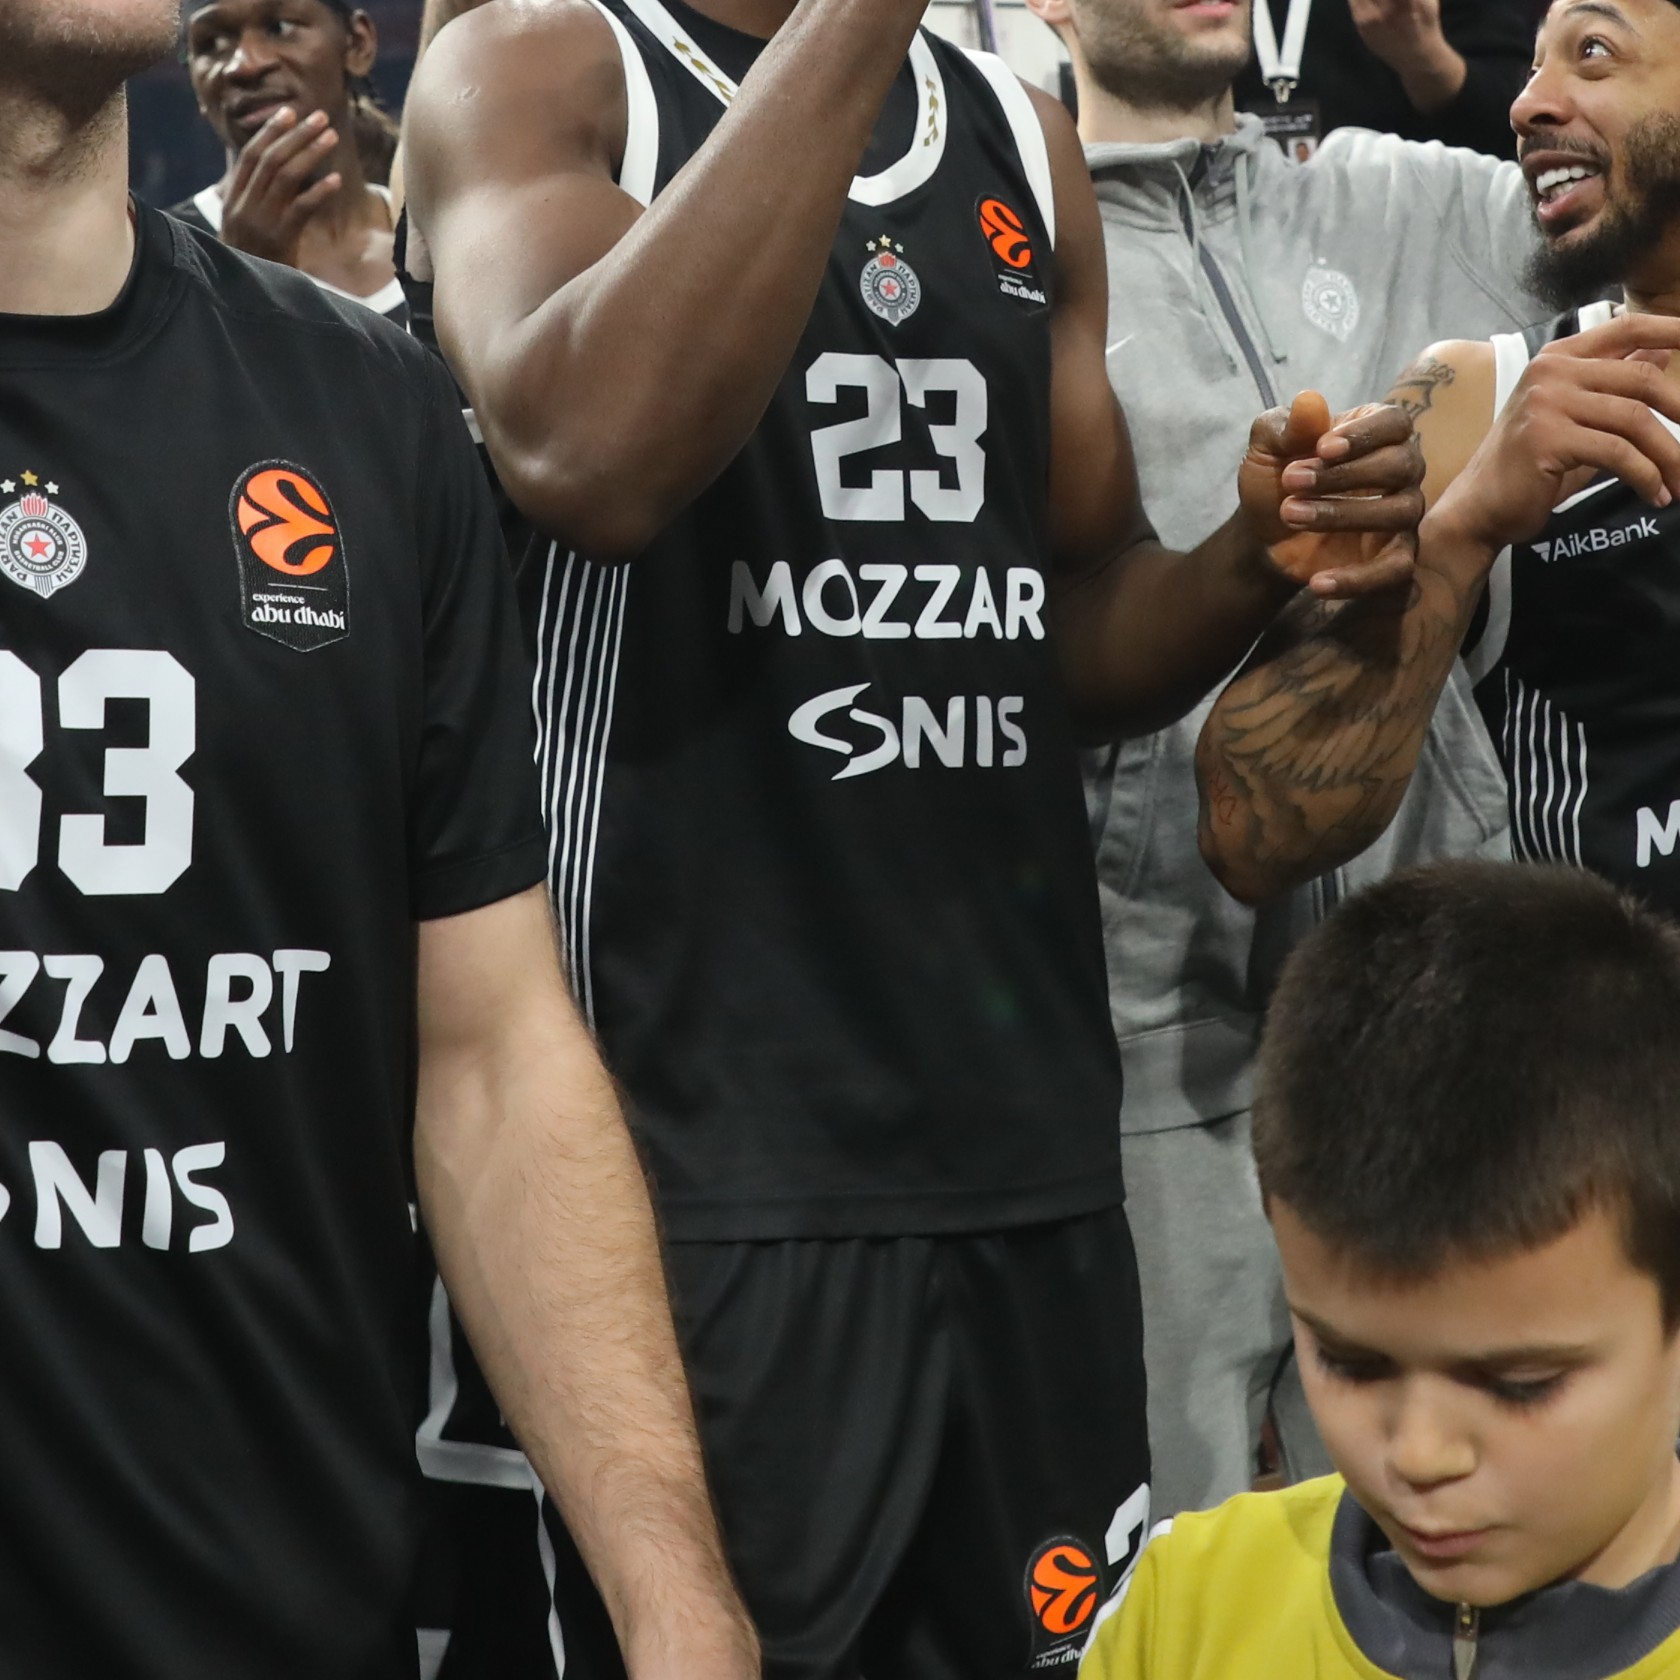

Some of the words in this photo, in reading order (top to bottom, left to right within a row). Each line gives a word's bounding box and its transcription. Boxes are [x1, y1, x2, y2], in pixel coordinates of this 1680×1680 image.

[805, 352, 988, 522] 23
[51, 513, 81, 582] ПАРТИЗАН
[1553, 517, 1660, 561] AikBank
[251, 603, 291, 624] abu
[294, 606, 345, 630] dhabi
[252, 593, 305, 604] experience
[727, 559, 1045, 640] MOZZAR
[902, 695, 1027, 769] NIS
[28, 1140, 235, 1253] NIS
